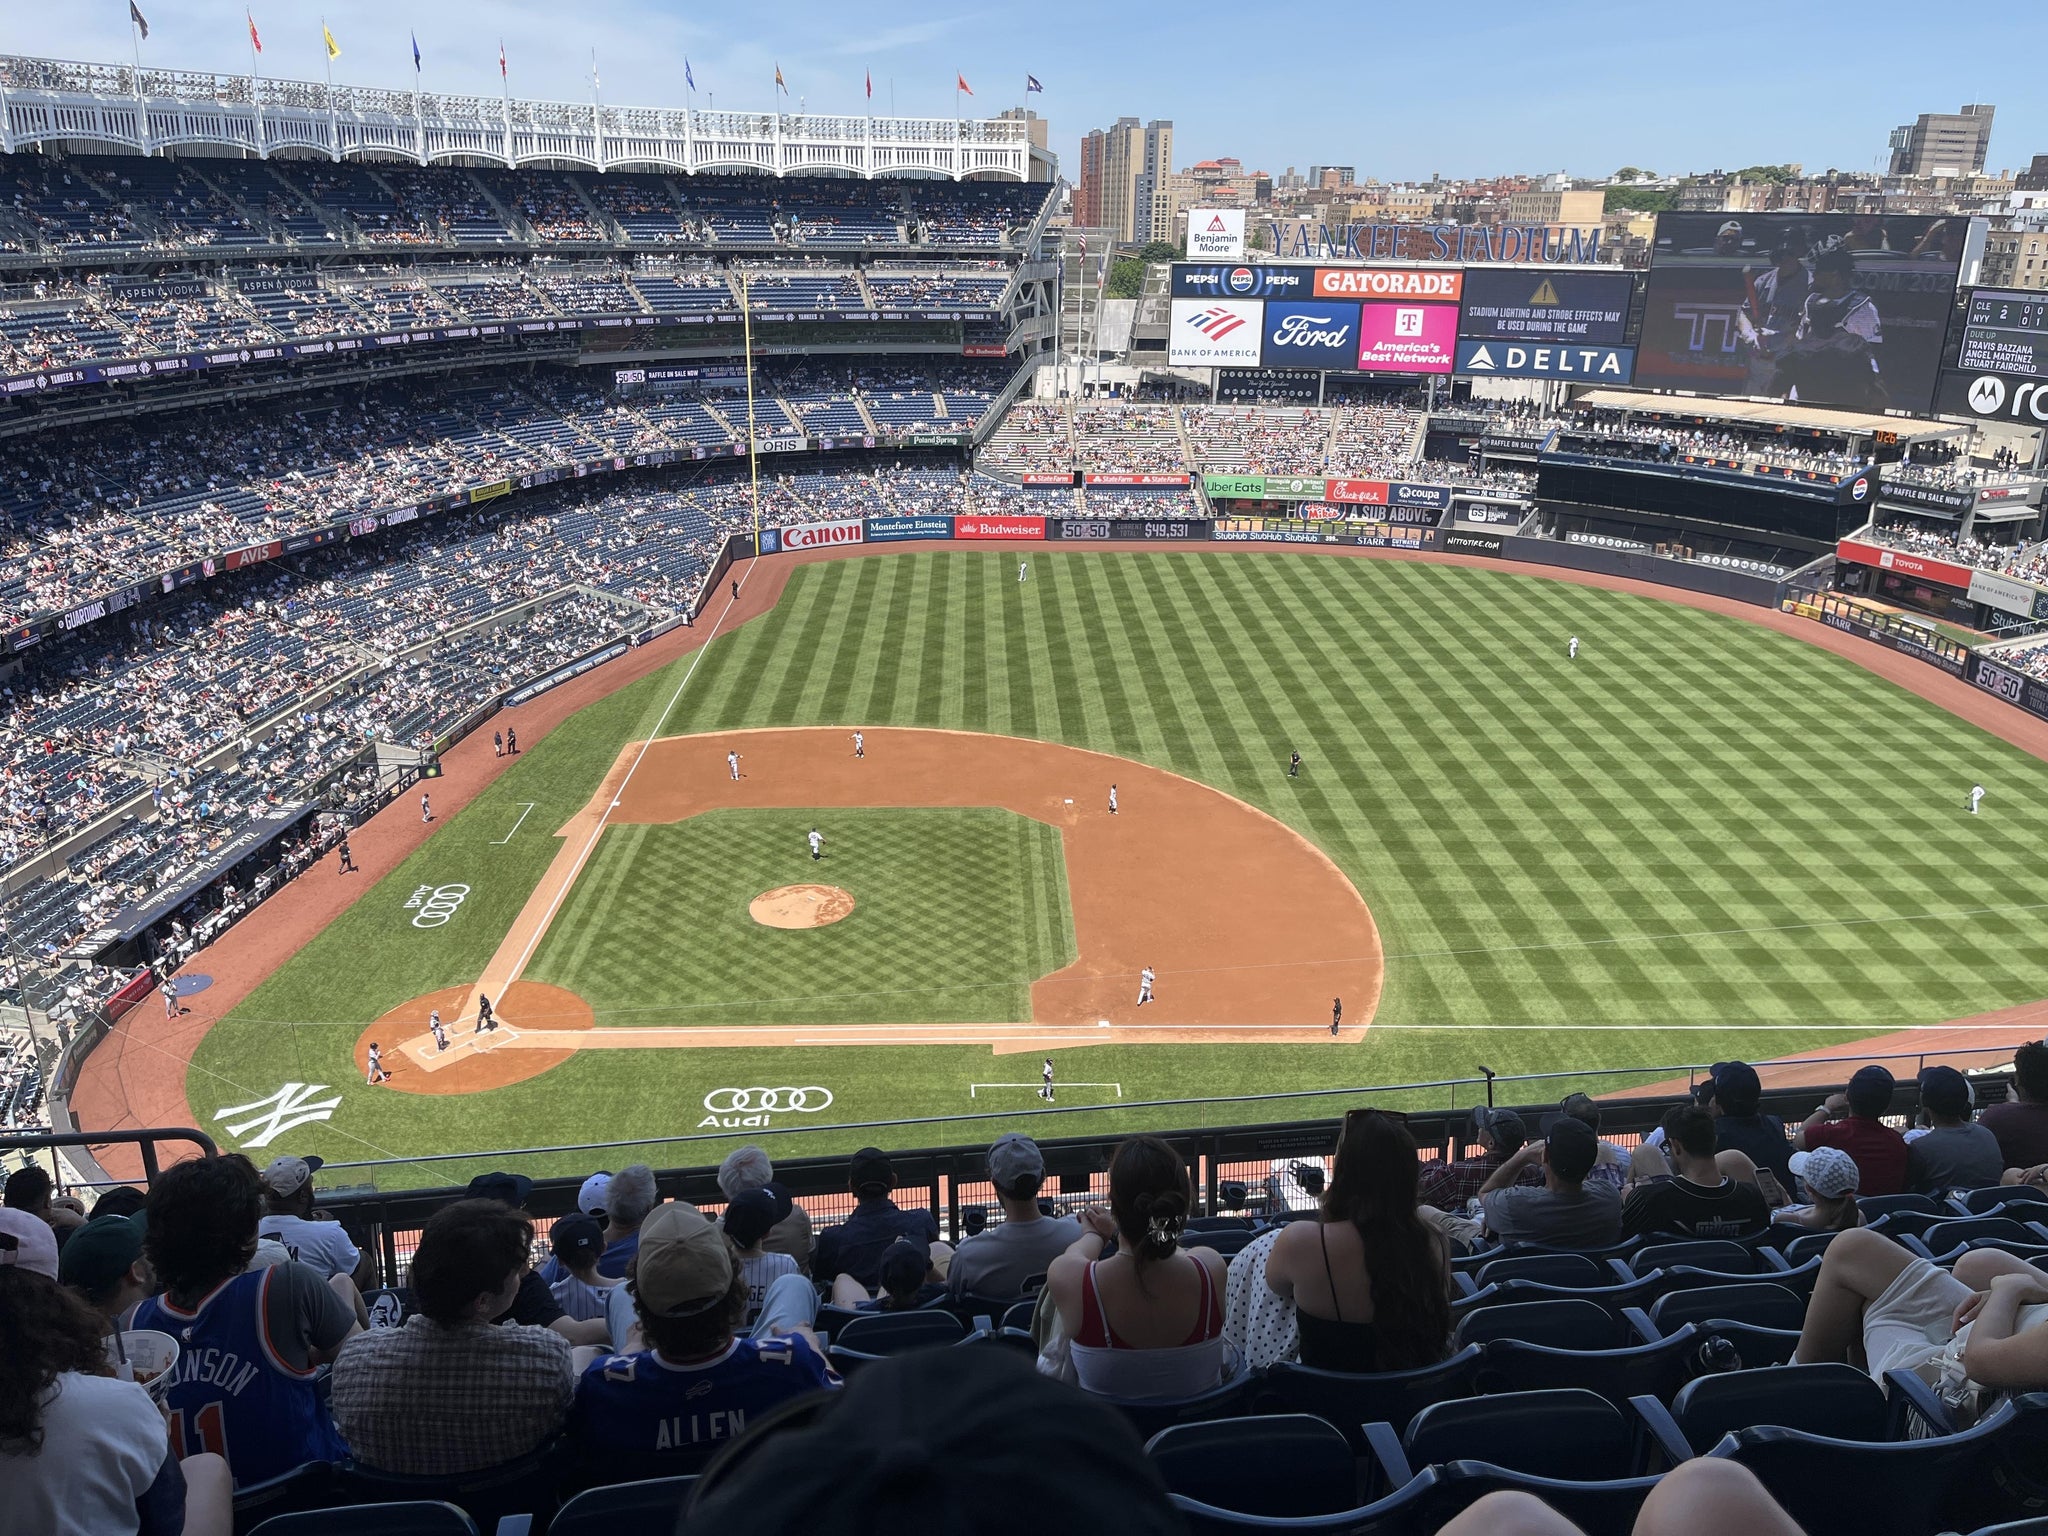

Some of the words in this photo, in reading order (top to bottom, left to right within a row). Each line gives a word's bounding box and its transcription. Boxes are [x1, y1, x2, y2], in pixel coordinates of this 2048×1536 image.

[1194, 233, 1238, 244] Benjamin
[1268, 223, 1410, 260] YANKEE
[1430, 224, 1601, 265] STADIUM
[1199, 243, 1230, 253] Moore
[243, 279, 273, 291] ASPEN
[284, 277, 314, 289] VODKA
[1185, 274, 1219, 284] PEPSI
[1265, 276, 1299, 286] PEPSI
[1322, 272, 1456, 295] GATORADE
[119, 286, 155, 300] ASPEN
[165, 284, 201, 297] VODKA
[1469, 306, 1499, 317] STADIUM
[1500, 307, 1530, 319] LIGHTING
[1531, 308, 1546, 319] AND
[1547, 309, 1573, 320] STROBE
[1574, 310, 1603, 322] EFFECTS
[1604, 311, 1621, 323] MAY
[1976, 301, 1991, 311] CLE
[2000, 309, 2008, 320] 2
[2023, 305, 2030, 314] 0
[2037, 306, 2044, 315] 0
[1497, 320, 1506, 330] BE
[1507, 320, 1525, 331] USED
[1526, 321, 1552, 332] DURING
[1553, 322, 1567, 333] THE
[1567, 323, 1588, 334] GAME
[1973, 314, 1990, 324] NYY
[2021, 317, 2028, 326] 0
[2036, 317, 2041, 327] 1
[1272, 314, 1350, 348] Ford
[1969, 330, 1985, 339] DUE
[1986, 331, 1997, 340] UP
[975, 347, 1005, 357] Budweiser
[1171, 349, 1197, 357] BANK
[1200, 349, 1212, 357] OF
[1214, 349, 1258, 358] AMERICA
[1372, 341, 1441, 353] America's
[1968, 340, 1996, 351] TRAVIS
[1997, 343, 2033, 355] BAZZANA
[212, 353, 239, 364] GUARDIANS
[253, 349, 275, 359] YANKEES
[1361, 351, 1392, 362] Best
[1393, 352, 1450, 365] Network
[1965, 349, 1991, 360] ANGEL
[154, 359, 180, 371] YANKEES
[1506, 347, 1621, 375] DELTA
[1963, 358, 1994, 369] STUART
[1995, 361, 2037, 374] FAIRCHILD
[106, 362, 138, 376] GUARDIANS
[50, 372, 74, 384] YANKEES
[618, 372, 629, 383] 50
[632, 372, 643, 382] 50
[648, 371, 666, 379] RAFFLE
[687, 369, 699, 377] NOW
[7, 380, 35, 393] GUARDIANS
[763, 440, 797, 452] ORIS
[913, 435, 935, 445] Poland
[936, 434, 958, 446] Spring
[1491, 439, 1510, 448] RAFFLE
[1511, 440, 1519, 448] ON
[1520, 441, 1534, 450] SALE
[1037, 475, 1053, 483] State
[1054, 475, 1068, 483] Farm
[1102, 475, 1117, 483] State
[1117, 475, 1133, 483] Farm
[1151, 475, 1166, 483] State
[1167, 476, 1182, 484] Farm
[1206, 481, 1232, 492] Uber
[1234, 482, 1262, 493] Eats
[1333, 484, 1379, 502] Chick-fil-A
[1411, 488, 1440, 500] coupa
[1893, 487, 1917, 498] RAFFLE
[1917, 490, 1927, 500] ON
[1927, 492, 1944, 503] SALE
[1945, 494, 1962, 506] NOW
[386, 506, 418, 527] GUARDIANS
[1350, 505, 1358, 518] A
[1362, 506, 1387, 521] SUB
[1389, 507, 1429, 523] ABOVE
[1471, 508, 1485, 517] GS
[870, 521, 914, 531] Montefiore
[915, 519, 947, 530] Einstein
[980, 523, 1041, 535] Budweiser
[1065, 524, 1082, 537] 50
[1089, 524, 1106, 537] 50
[1145, 523, 1188, 538] $49,531
[782, 524, 861, 548] Canon
[1215, 532, 1248, 541] StubHub
[1249, 532, 1282, 541] StubHub
[1284, 533, 1318, 542] StubHub
[1356, 536, 1385, 546] STARR
[1391, 538, 1420, 546] CUTWATER
[1447, 537, 1500, 550] NITTOTIRE.COM
[240, 545, 270, 566] AVIS
[1895, 558, 1924, 572] TOYOTA
[1971, 582, 1986, 591] BANK
[1994, 589, 2019, 601] AMERICA
[65, 602, 106, 630] GUARDIANS
[1826, 614, 1852, 631] STARR
[1991, 612, 2035, 636] StubHub
[1979, 666, 1997, 689] 50
[2000, 676, 2019, 699] 50
[403, 884, 434, 909] Audi
[696, 1114, 771, 1128] Audi
[755, 1337, 793, 1366] 17
[603, 1355, 638, 1383] 17
[656, 1408, 746, 1451] ALLEN
